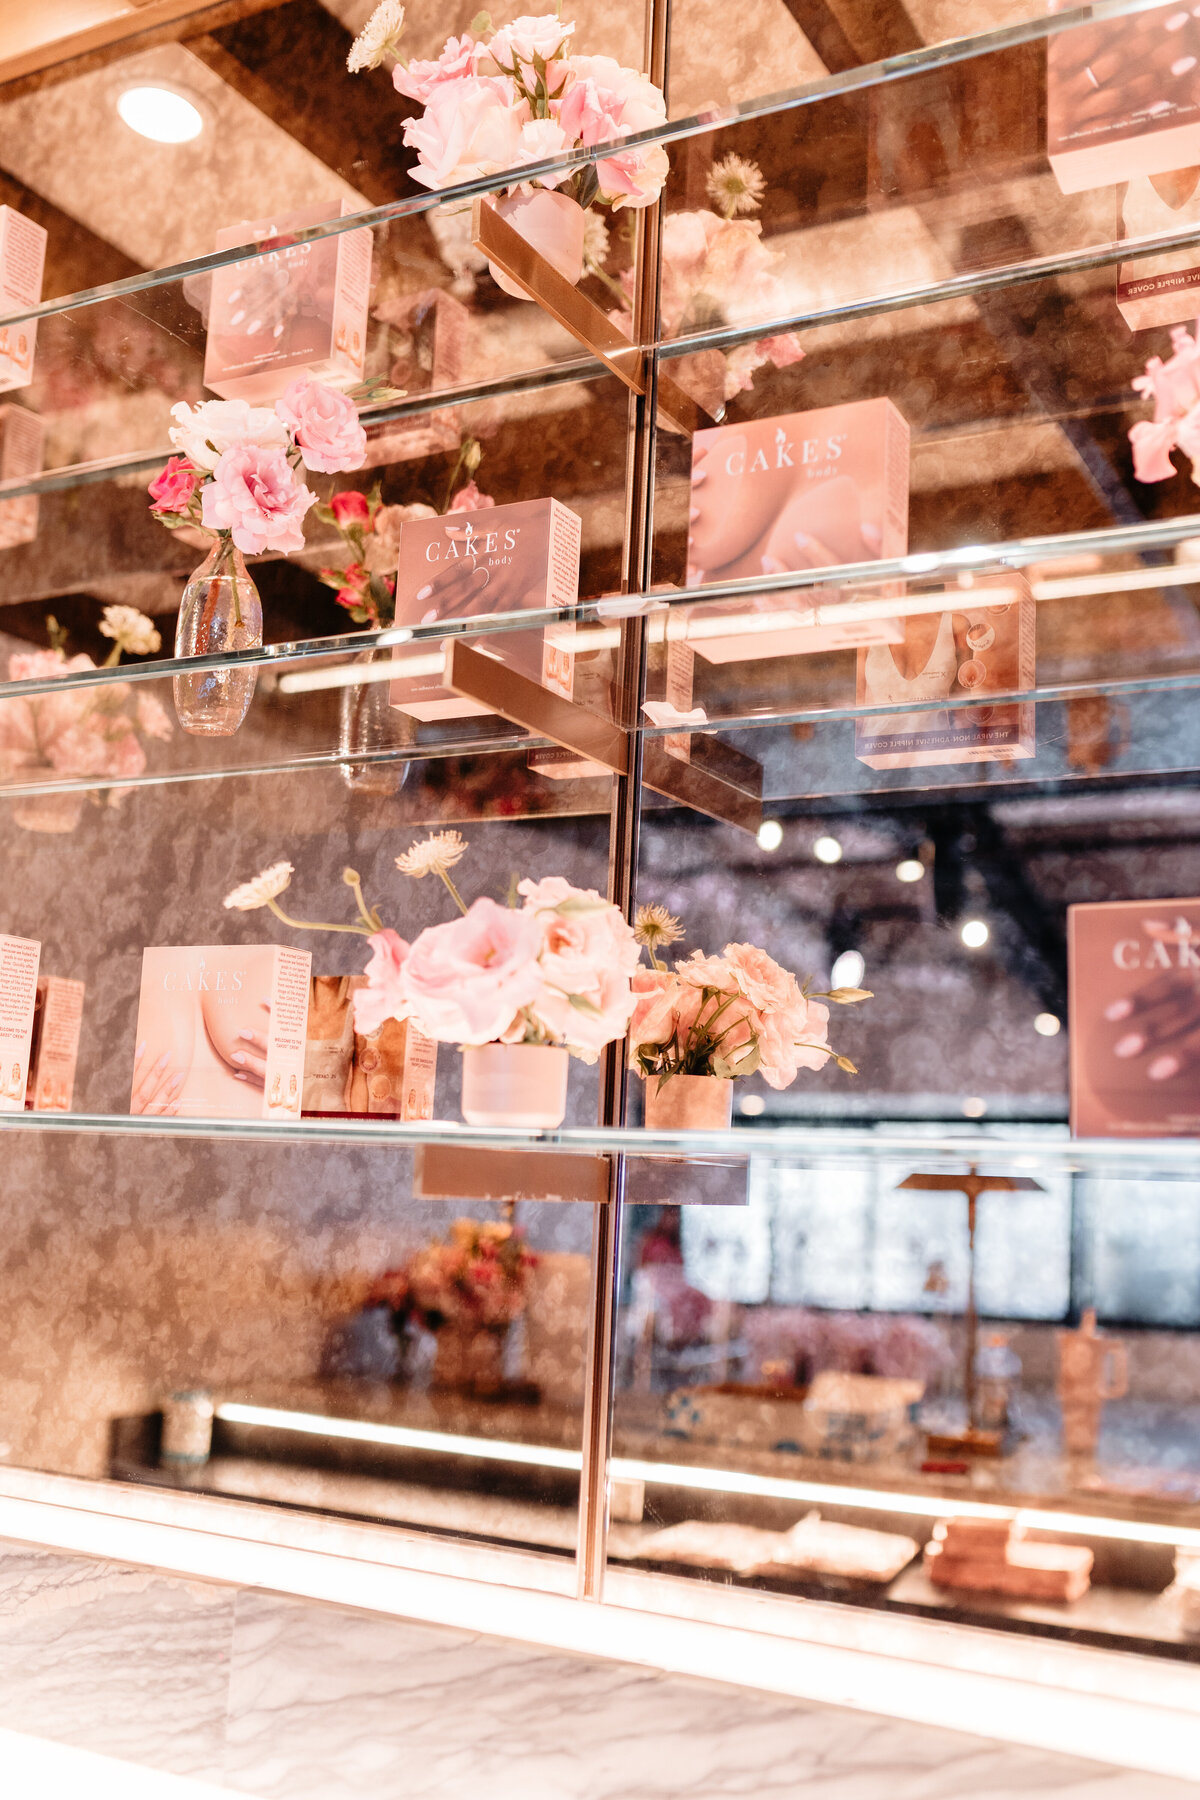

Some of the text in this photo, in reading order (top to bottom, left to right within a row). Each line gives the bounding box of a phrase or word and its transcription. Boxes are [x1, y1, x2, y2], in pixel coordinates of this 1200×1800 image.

[724, 436, 844, 476] CAKES
[425, 529, 518, 562] CAKES
[488, 555, 514, 567] body
[1112, 938, 1200, 970] CAK
[163, 970, 243, 991] CAKES
